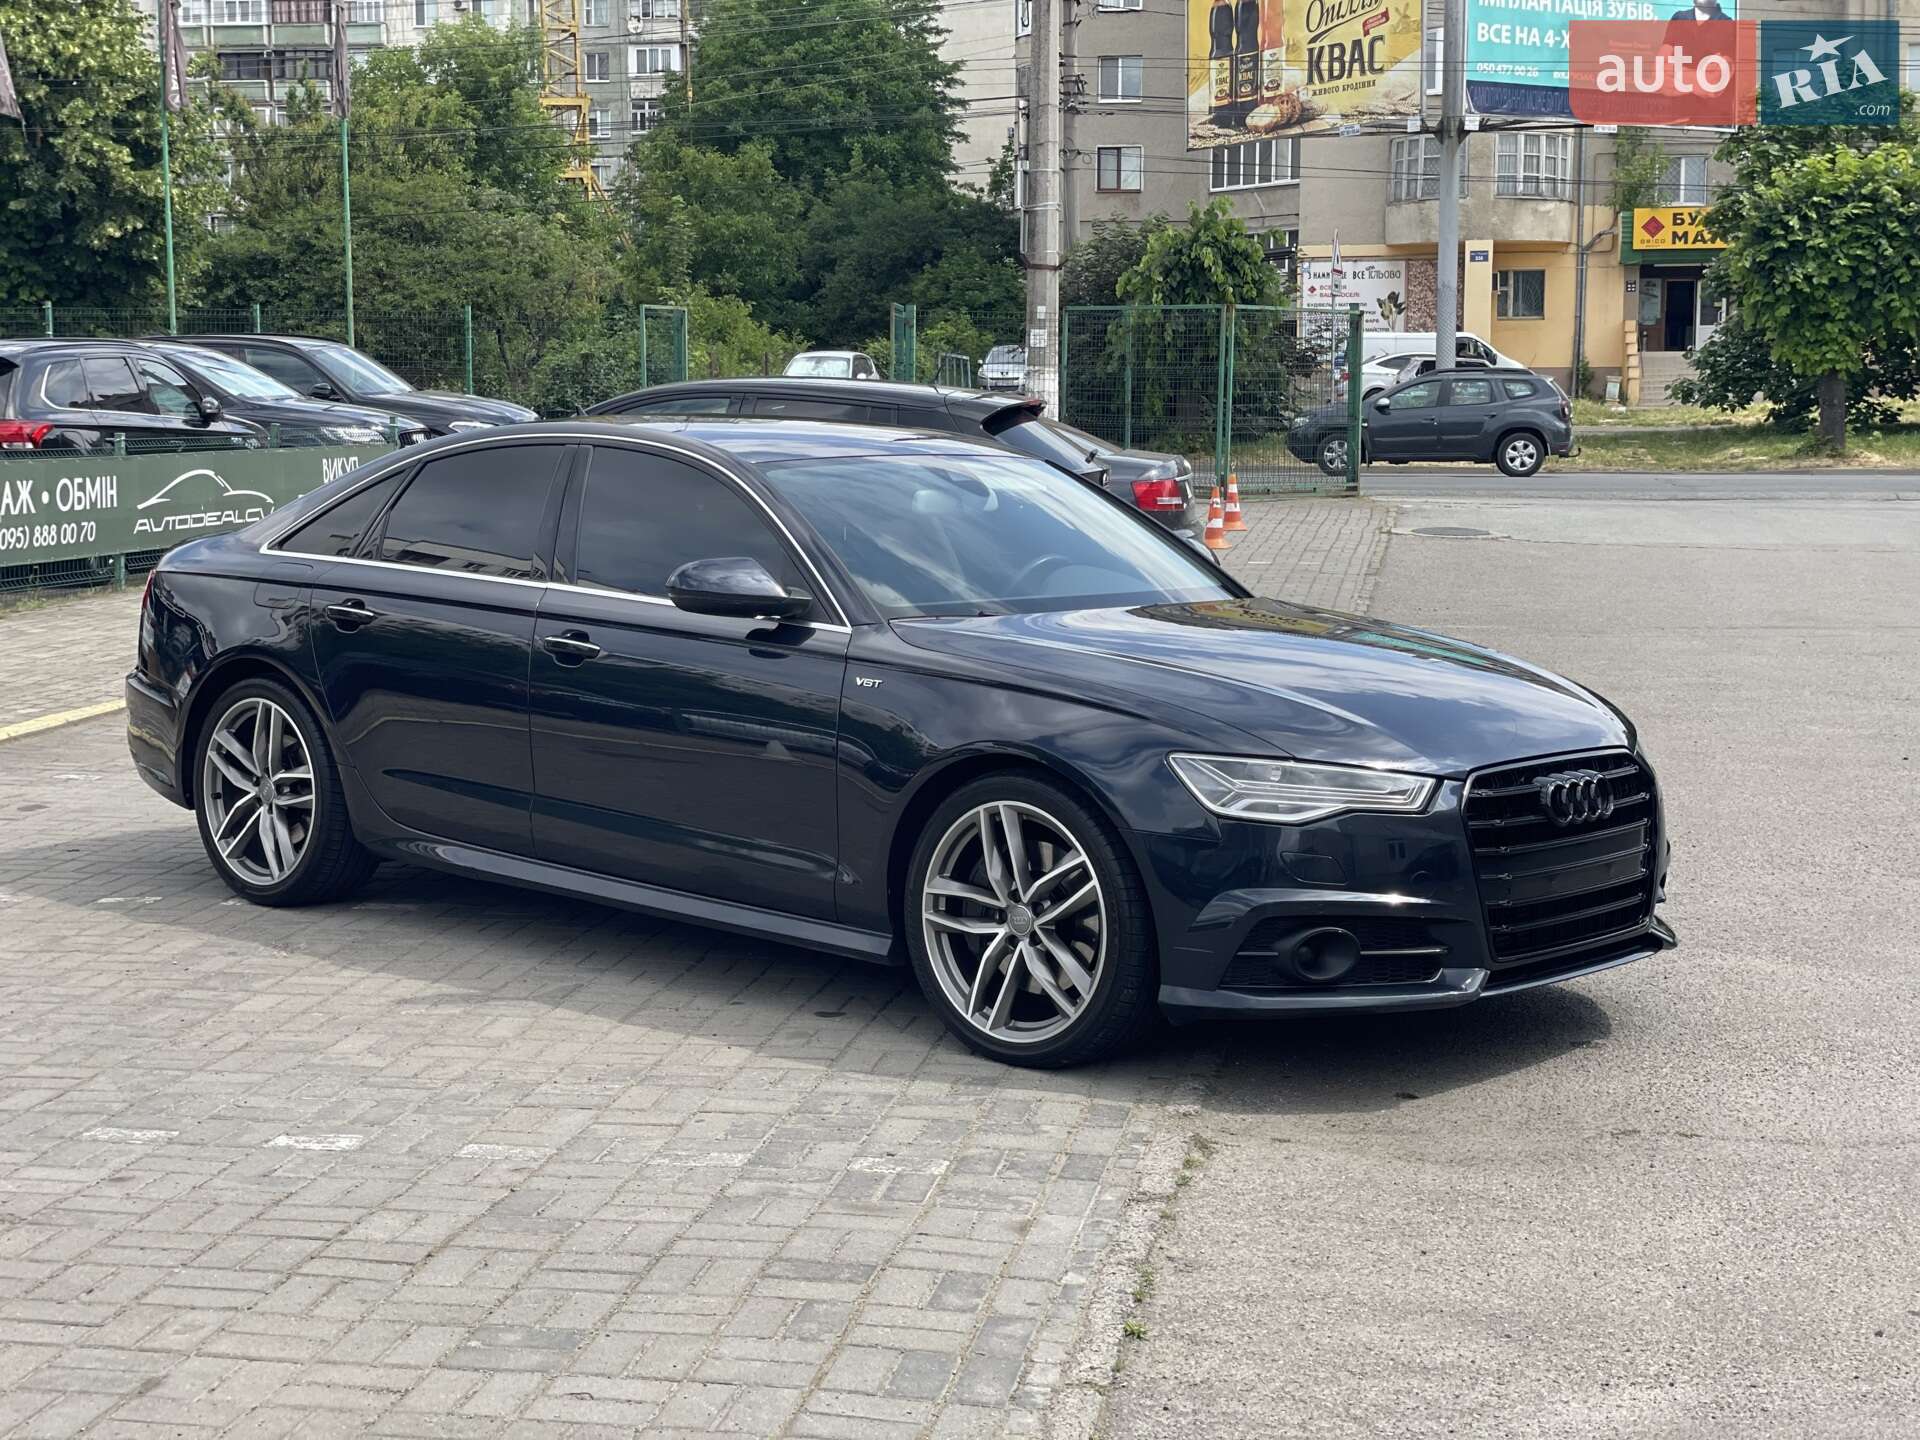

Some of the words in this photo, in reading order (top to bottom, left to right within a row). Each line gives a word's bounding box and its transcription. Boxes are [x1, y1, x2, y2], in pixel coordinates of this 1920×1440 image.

[1306, 0, 1379, 32] Опіл
[1477, 22, 1511, 44] ВСЕ
[1515, 25, 1541, 47] НА
[1307, 35, 1385, 86] КВАС
[1312, 86, 1340, 97] ЖИВОГО
[1342, 80, 1377, 92] БРОДІННЯ
[1352, 270, 1366, 280] ВСЕ
[1368, 270, 1402, 280] КЛЬОВО
[0, 480, 36, 516] АЖ
[56, 475, 117, 512] ОБМІН
[33, 524, 57, 547] 888
[60, 522, 77, 545] 00
[80, 521, 96, 542] 70
[856, 676, 883, 688] V6T
